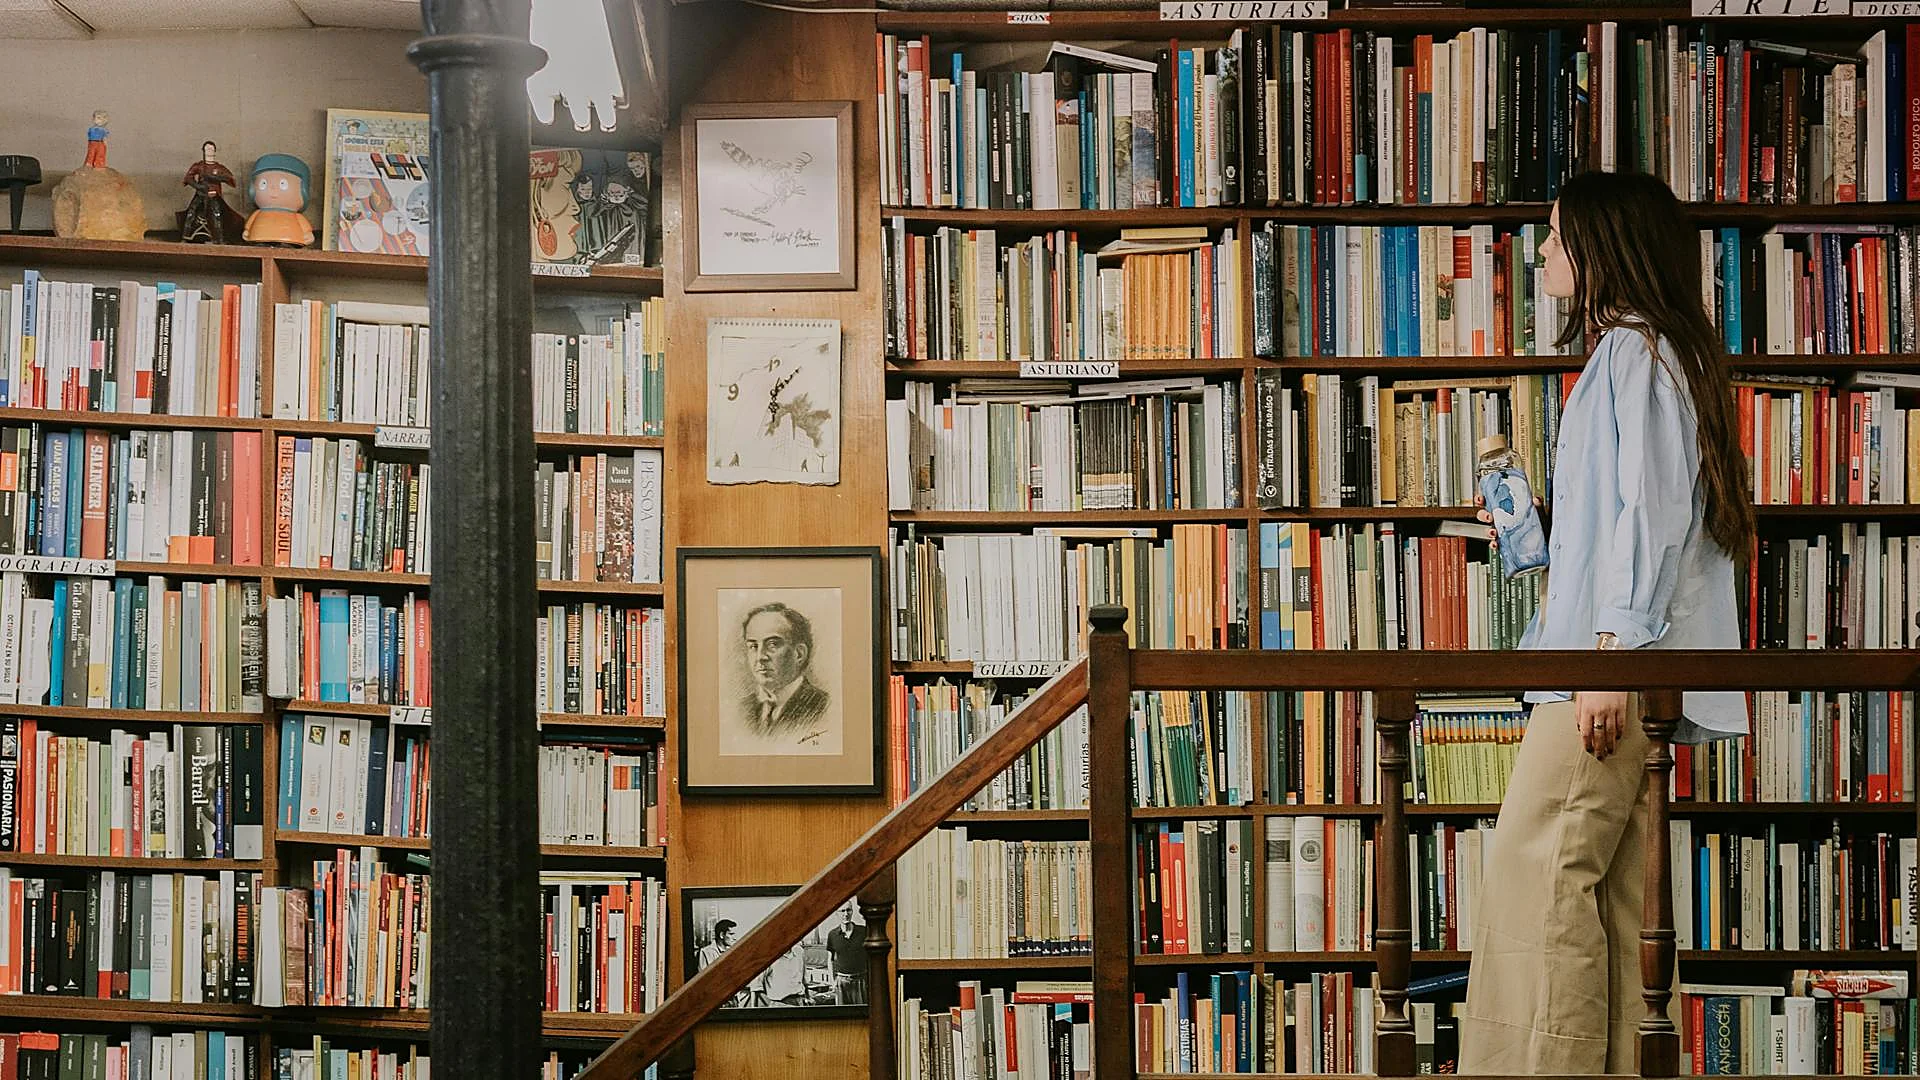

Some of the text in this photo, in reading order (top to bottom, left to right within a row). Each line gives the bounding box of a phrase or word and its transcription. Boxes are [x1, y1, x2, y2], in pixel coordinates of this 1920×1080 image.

[1012, 12, 1046, 23] GIJÓN
[1171, 3, 1316, 19] ASTURIAS
[1709, 0, 1832, 15] ARTE
[1302, 57, 1311, 84] Asturias
[1706, 46, 1715, 75] DIBUJO
[1708, 77, 1714, 87] DE
[1257, 122, 1264, 130] DE
[1912, 98, 1920, 170] RODOLFO PICO
[1257, 132, 1265, 156] PUERTO
[1028, 365, 1109, 376] ASTURIANO
[52, 440, 62, 463] JUAN
[382, 430, 431, 445] NARRAT
[1264, 395, 1275, 479] ENTRADAS AL PARAÍSO
[51, 466, 61, 502] CARLOS
[88, 445, 104, 509] SALINGER
[340, 464, 353, 499] JPod
[609, 476, 633, 485] Auster
[611, 465, 629, 476] Paul
[409, 480, 418, 512] PAUL AUSTER
[640, 460, 655, 522] PESSOA
[279, 523, 290, 555] SOUL
[0, 558, 110, 575] OGRAFIAS
[7, 614, 15, 637] OCTAVIO
[71, 582, 83, 641] Gil de Biedma
[249, 590, 258, 677] BRUCE SPRINGSTEEN
[5, 658, 12, 666] SU
[981, 663, 1050, 677] GUÍAS DE
[191, 755, 209, 805] Barral
[1080, 743, 1090, 789] Asturias
[1, 769, 14, 836] PASIONARIA
[1908, 866, 1920, 926] FASHION
[1239, 1000, 1247, 1022] Asturias
[1179, 1018, 1190, 1062] ASTURIAS
[1718, 1004, 1731, 1049] GOGH
[1775, 1028, 1784, 1064] T-SHIRT
